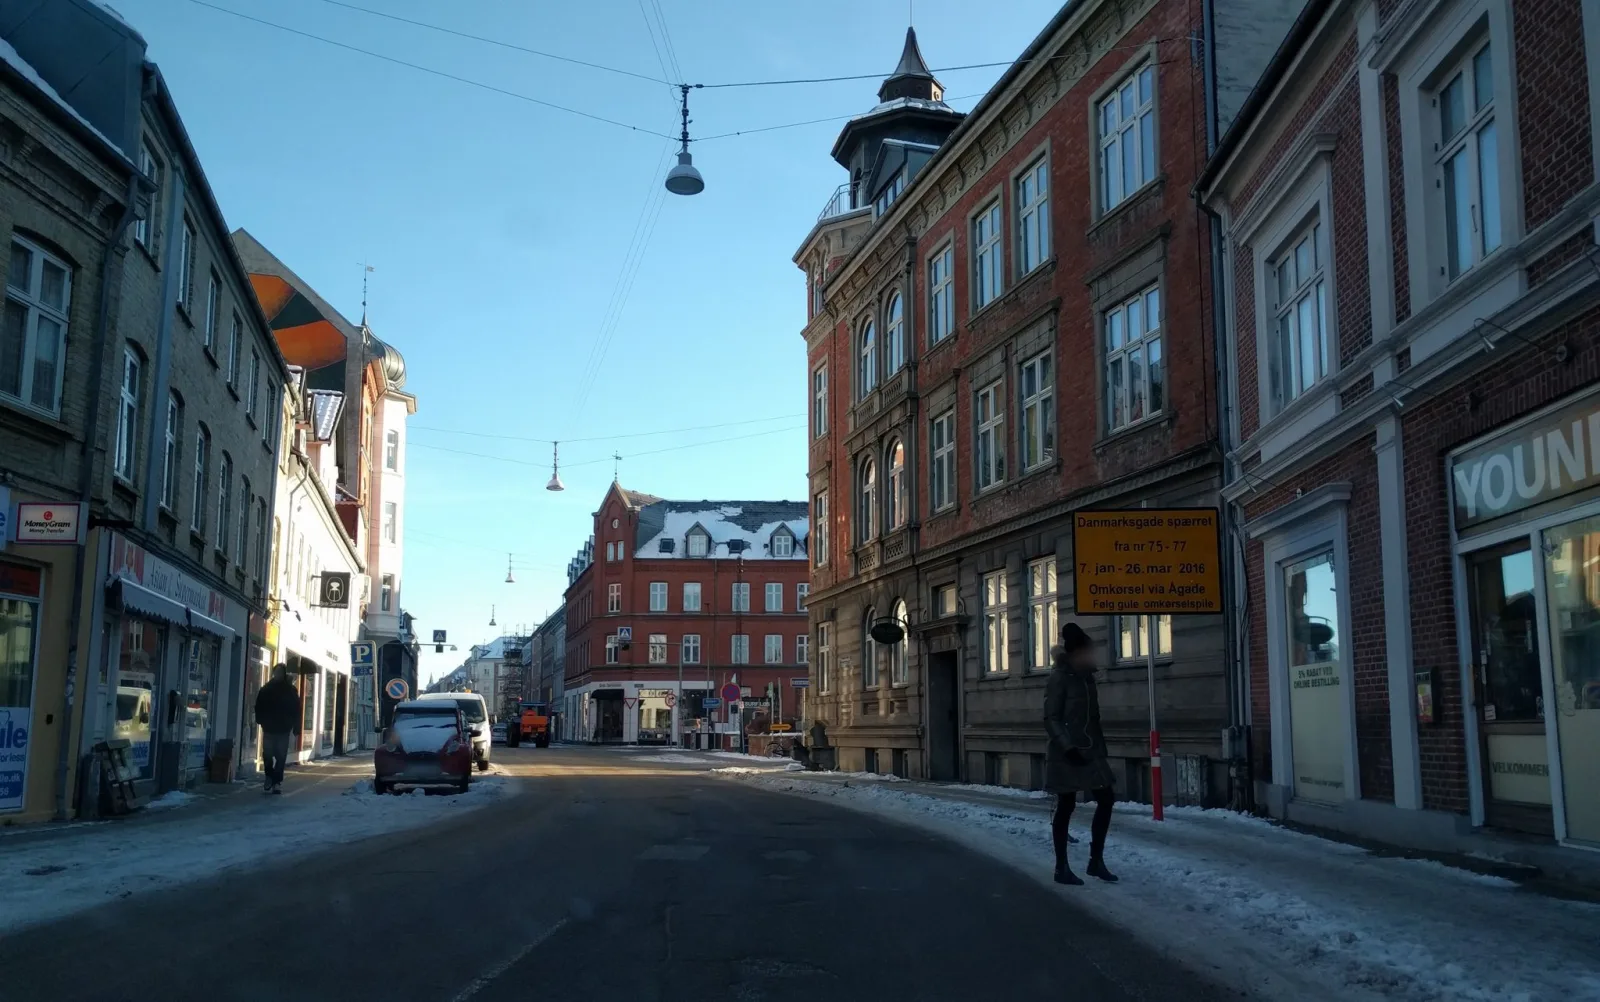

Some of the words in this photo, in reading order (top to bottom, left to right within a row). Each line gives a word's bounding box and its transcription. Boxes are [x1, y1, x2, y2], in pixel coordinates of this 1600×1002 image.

[24, 520, 70, 528] MoneyGram
[1078, 516, 1164, 529] Danmarksgade
[1167, 516, 1212, 529] spærret
[1114, 541, 1130, 551] fra
[1134, 542, 1146, 551] nr
[1172, 540, 1186, 551] 77
[1080, 564, 1091, 574] 7.
[1095, 562, 1115, 576] jan
[1179, 563, 1205, 574] 2016
[1089, 584, 1145, 595] Omkørsel
[1148, 584, 1164, 594] via
[1168, 582, 1205, 596] Ågade
[1093, 600, 1114, 611] Følg
[1118, 600, 1139, 611] gule
[1144, 599, 1214, 612] omkørselspile
[354, 646, 370, 662] P
[1311, 676, 1340, 687] BESTILLING
[1492, 761, 1549, 777] VELKOMMEN
